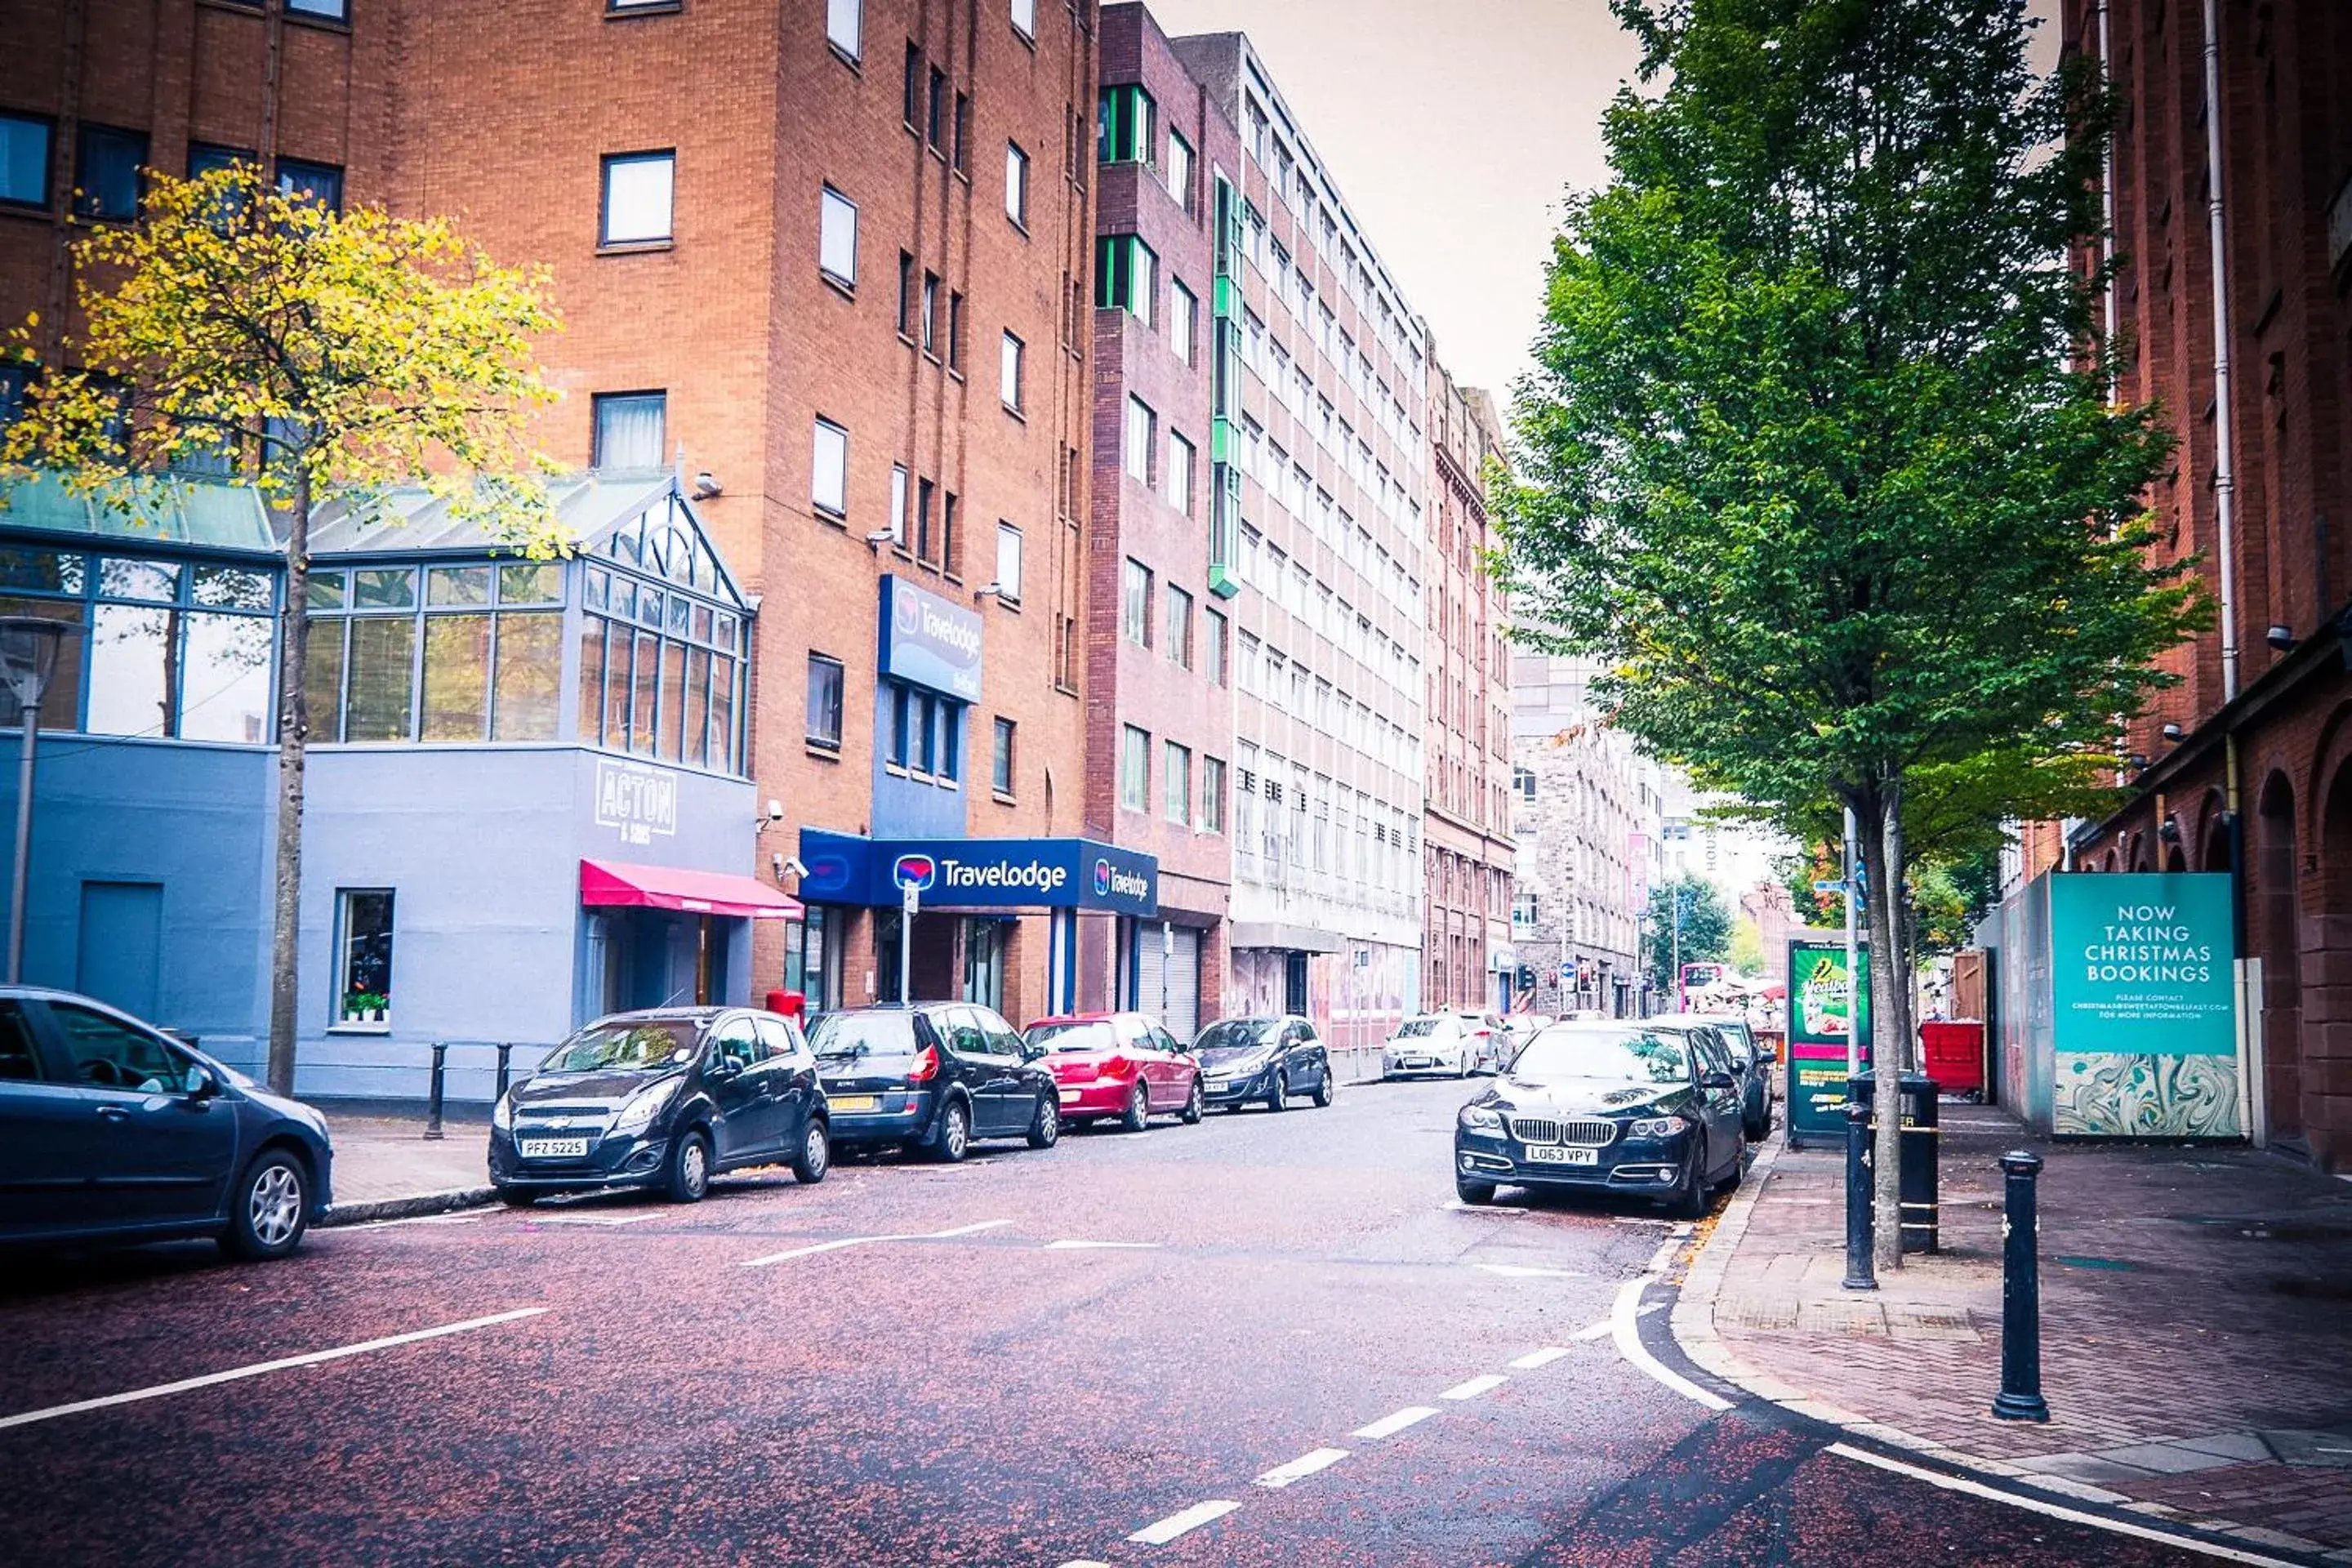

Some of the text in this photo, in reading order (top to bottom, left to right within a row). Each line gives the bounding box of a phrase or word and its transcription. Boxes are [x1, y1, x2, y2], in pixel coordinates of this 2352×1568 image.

[921, 602, 980, 660] Travelodge
[600, 770, 672, 825] ACTON
[941, 860, 1067, 893] Travelodge
[1110, 866, 1148, 902] Travelodge
[2118, 906, 2176, 921] NOW
[2104, 926, 2190, 942] TAKING
[2084, 945, 2212, 962] CHRISTMAS
[2087, 965, 2210, 982] BOOKINGS
[2116, 994, 2184, 1002] PLEASE CONTACT
[2099, 1011, 2203, 1020] FOR MORE INFORMATION
[527, 1142, 582, 1155] PFZ 5225
[1531, 1147, 1592, 1162] LO63 VPY
